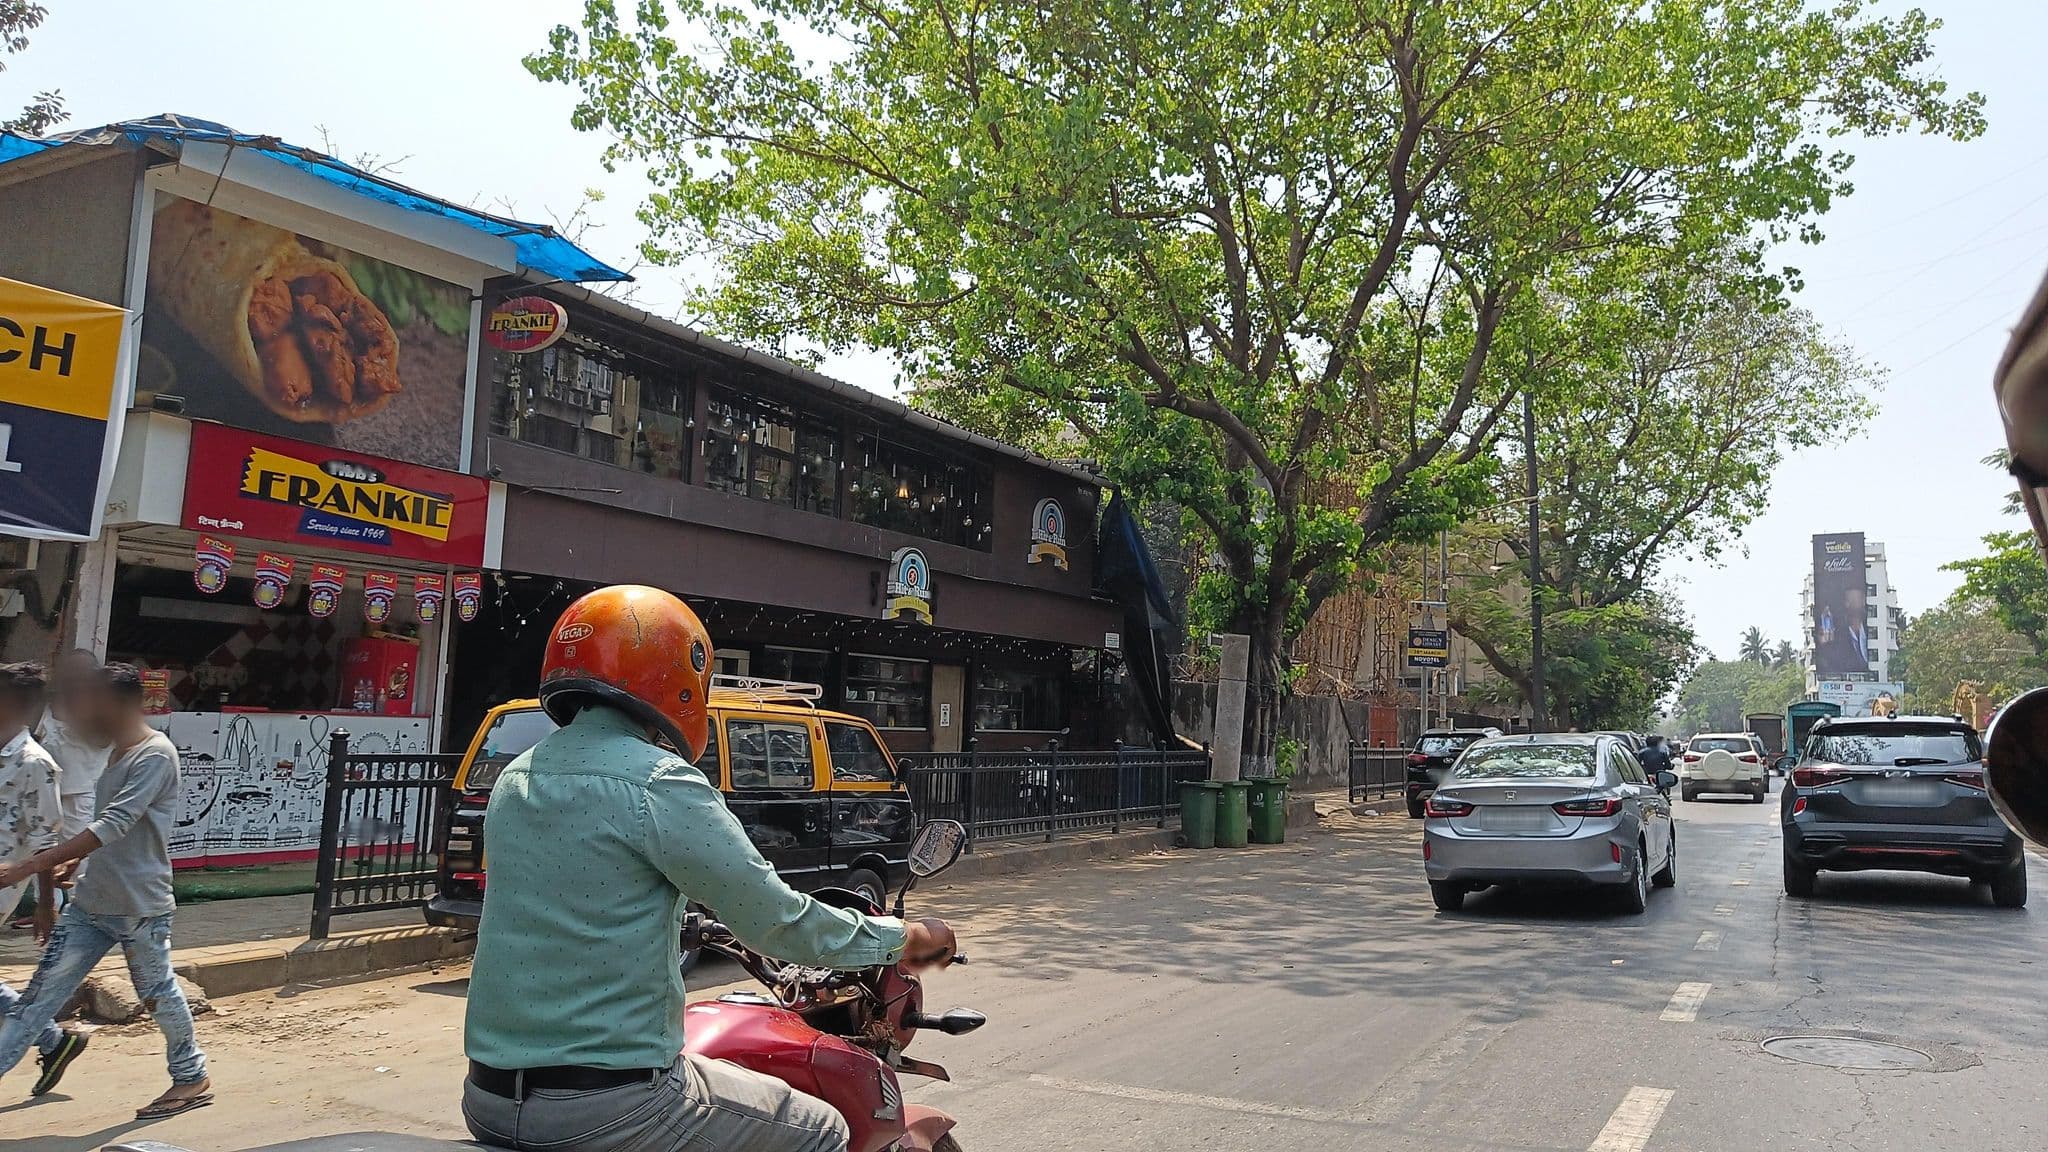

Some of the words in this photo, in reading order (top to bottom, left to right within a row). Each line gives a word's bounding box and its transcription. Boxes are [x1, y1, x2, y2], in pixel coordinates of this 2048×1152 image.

[489, 314, 553, 331] FRANKIE
[258, 470, 449, 528] FRANKIE
[307, 518, 339, 535] Serving
[340, 525, 360, 537] since
[362, 526, 385, 540] 1969
